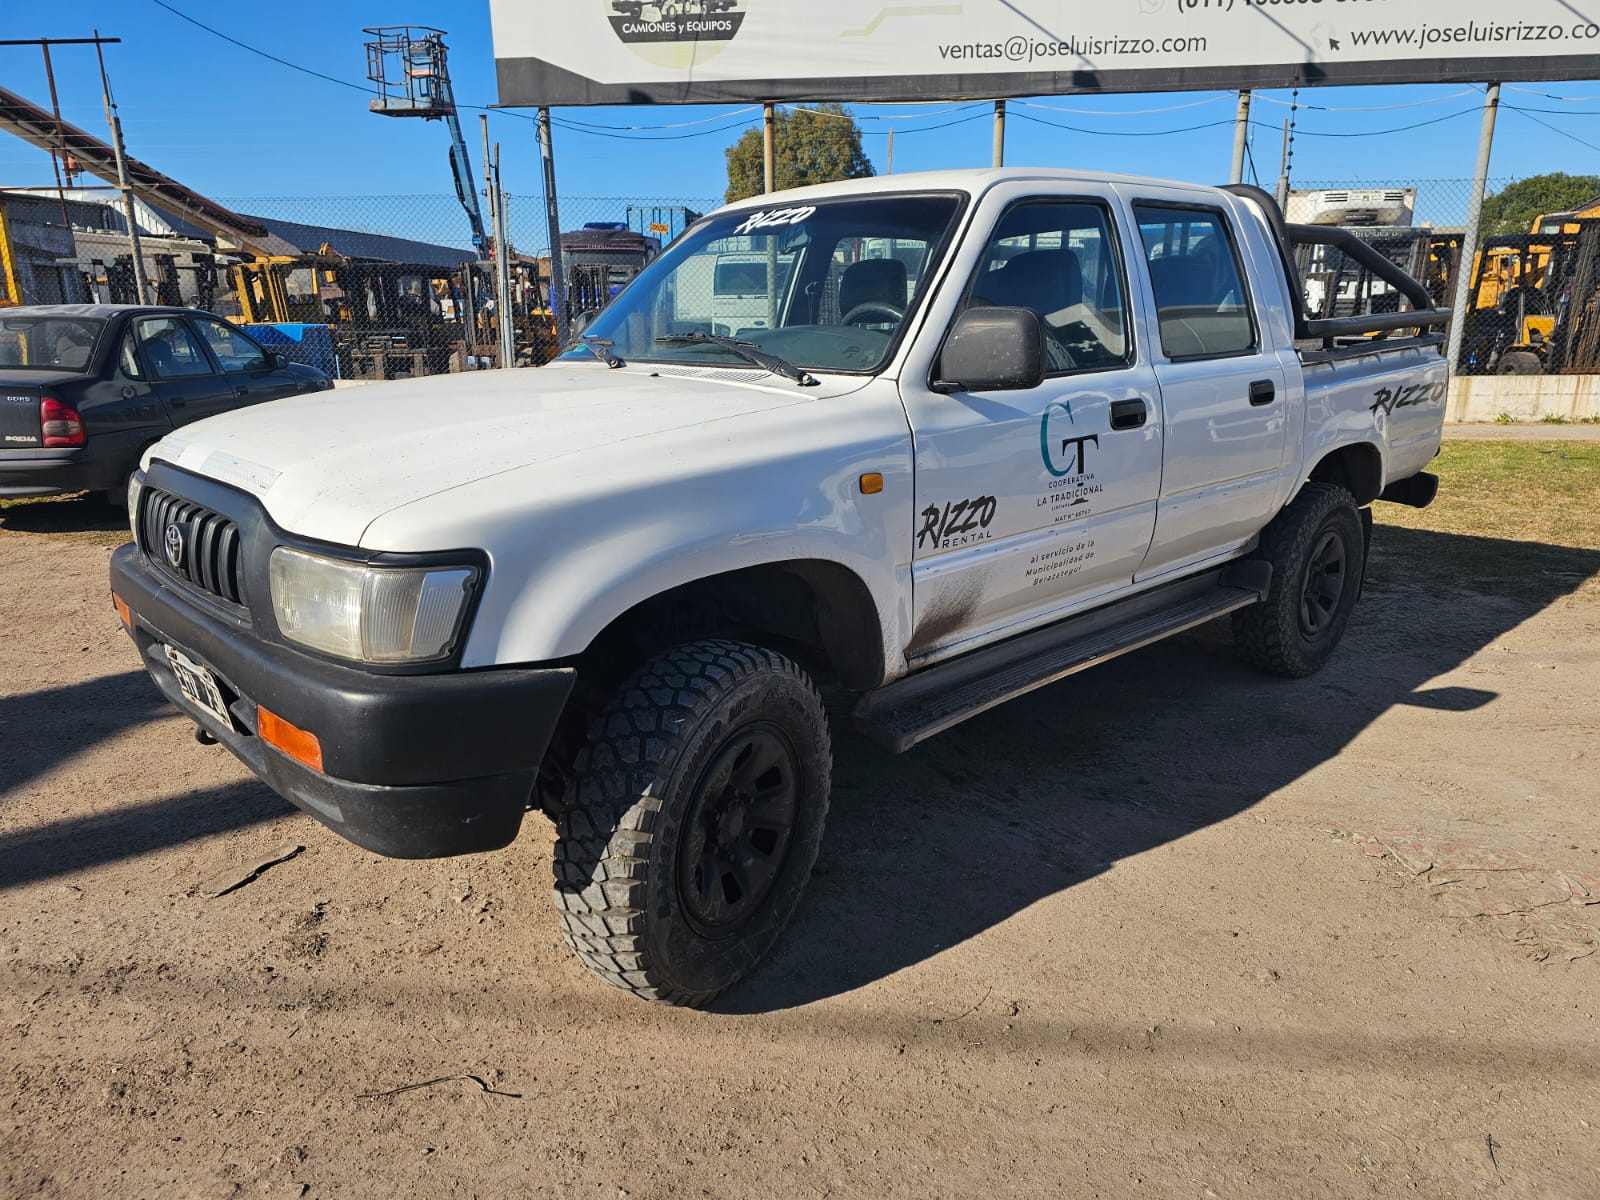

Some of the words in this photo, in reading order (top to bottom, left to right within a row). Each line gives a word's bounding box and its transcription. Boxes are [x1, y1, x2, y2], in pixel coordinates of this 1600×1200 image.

[622, 22, 677, 34] CAMIONES
[678, 24, 685, 34] y
[686, 20, 732, 32] EQUIPOS
[938, 35, 1208, 63] ventas@joseluisrizzo.com
[733, 206, 817, 235] RIZZO
[1369, 381, 1446, 417] RIZZO
[1048, 472, 1095, 489] COOPERATIVA
[1037, 496, 1048, 507] LA
[1050, 483, 1104, 504] TRADICIONAL
[916, 495, 998, 550] RIZZO
[942, 531, 992, 549] RENTAL
[1025, 553, 1083, 577] Municipalidad
[1085, 551, 1094, 560] de
[1030, 554, 1039, 564] al
[1041, 546, 1074, 561] servicio
[1076, 542, 1085, 551] de
[1032, 564, 1082, 586] Berazategui
